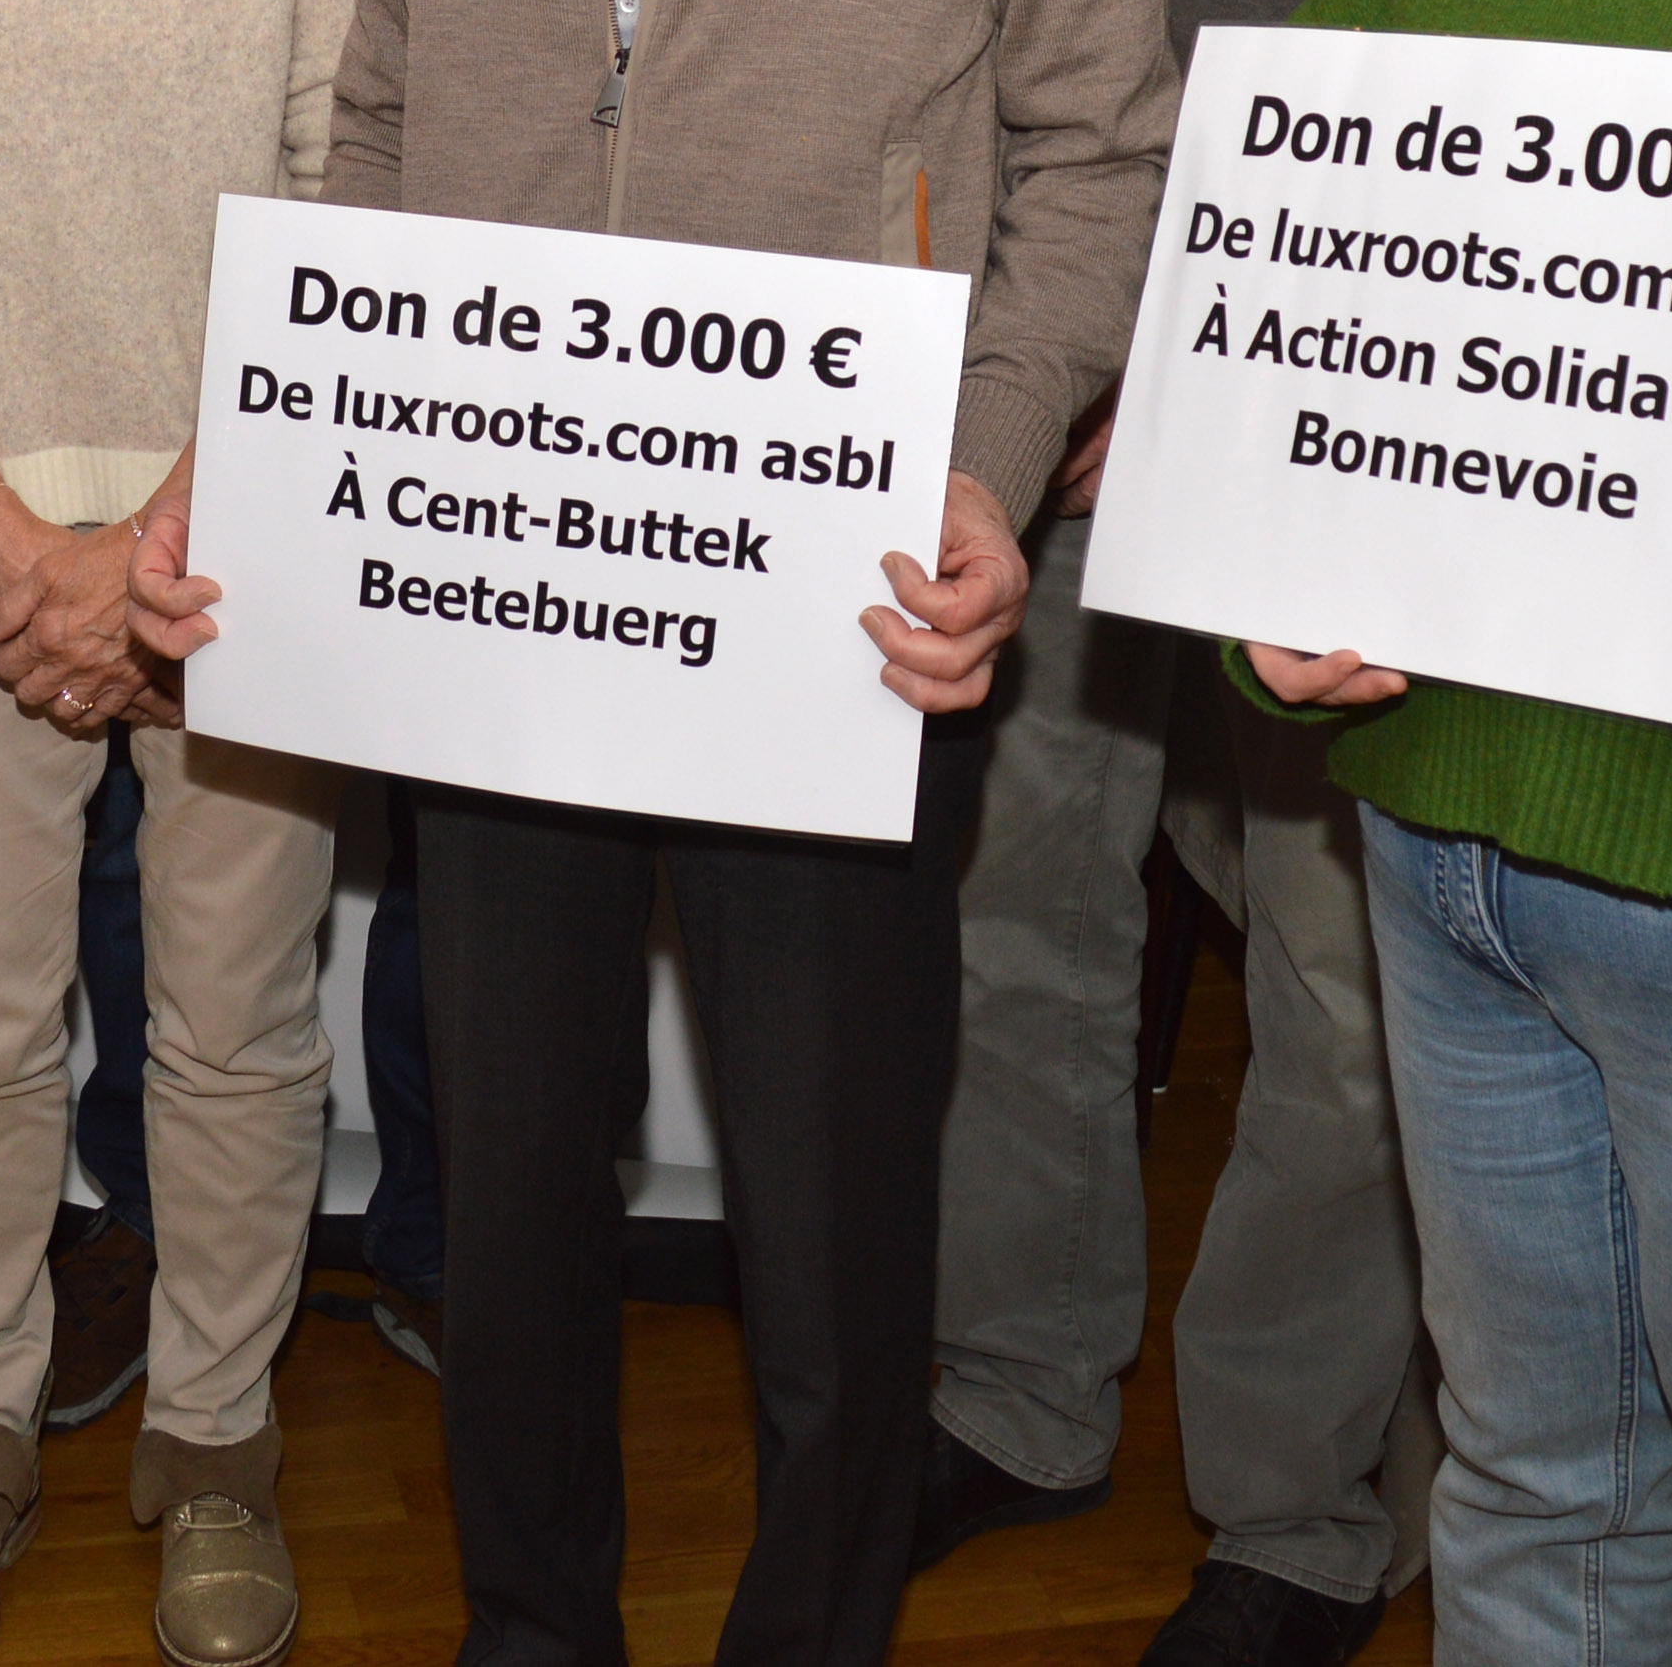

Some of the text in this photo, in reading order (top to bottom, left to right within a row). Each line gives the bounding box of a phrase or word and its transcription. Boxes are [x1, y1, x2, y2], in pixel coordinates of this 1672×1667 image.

[1242, 95, 1373, 166] Don
[1395, 105, 1483, 177] de
[1185, 202, 1254, 259] De
[288, 266, 862, 389] Don de 3.000 €
[1192, 283, 1228, 357] À
[1244, 309, 1436, 386] Action
[238, 364, 896, 493] De luxroots.com asbl
[1289, 410, 1639, 520] Bonnevoie
[326, 450, 771, 574] À Cent-Buttek
[359, 558, 718, 668] Beetebuerg
